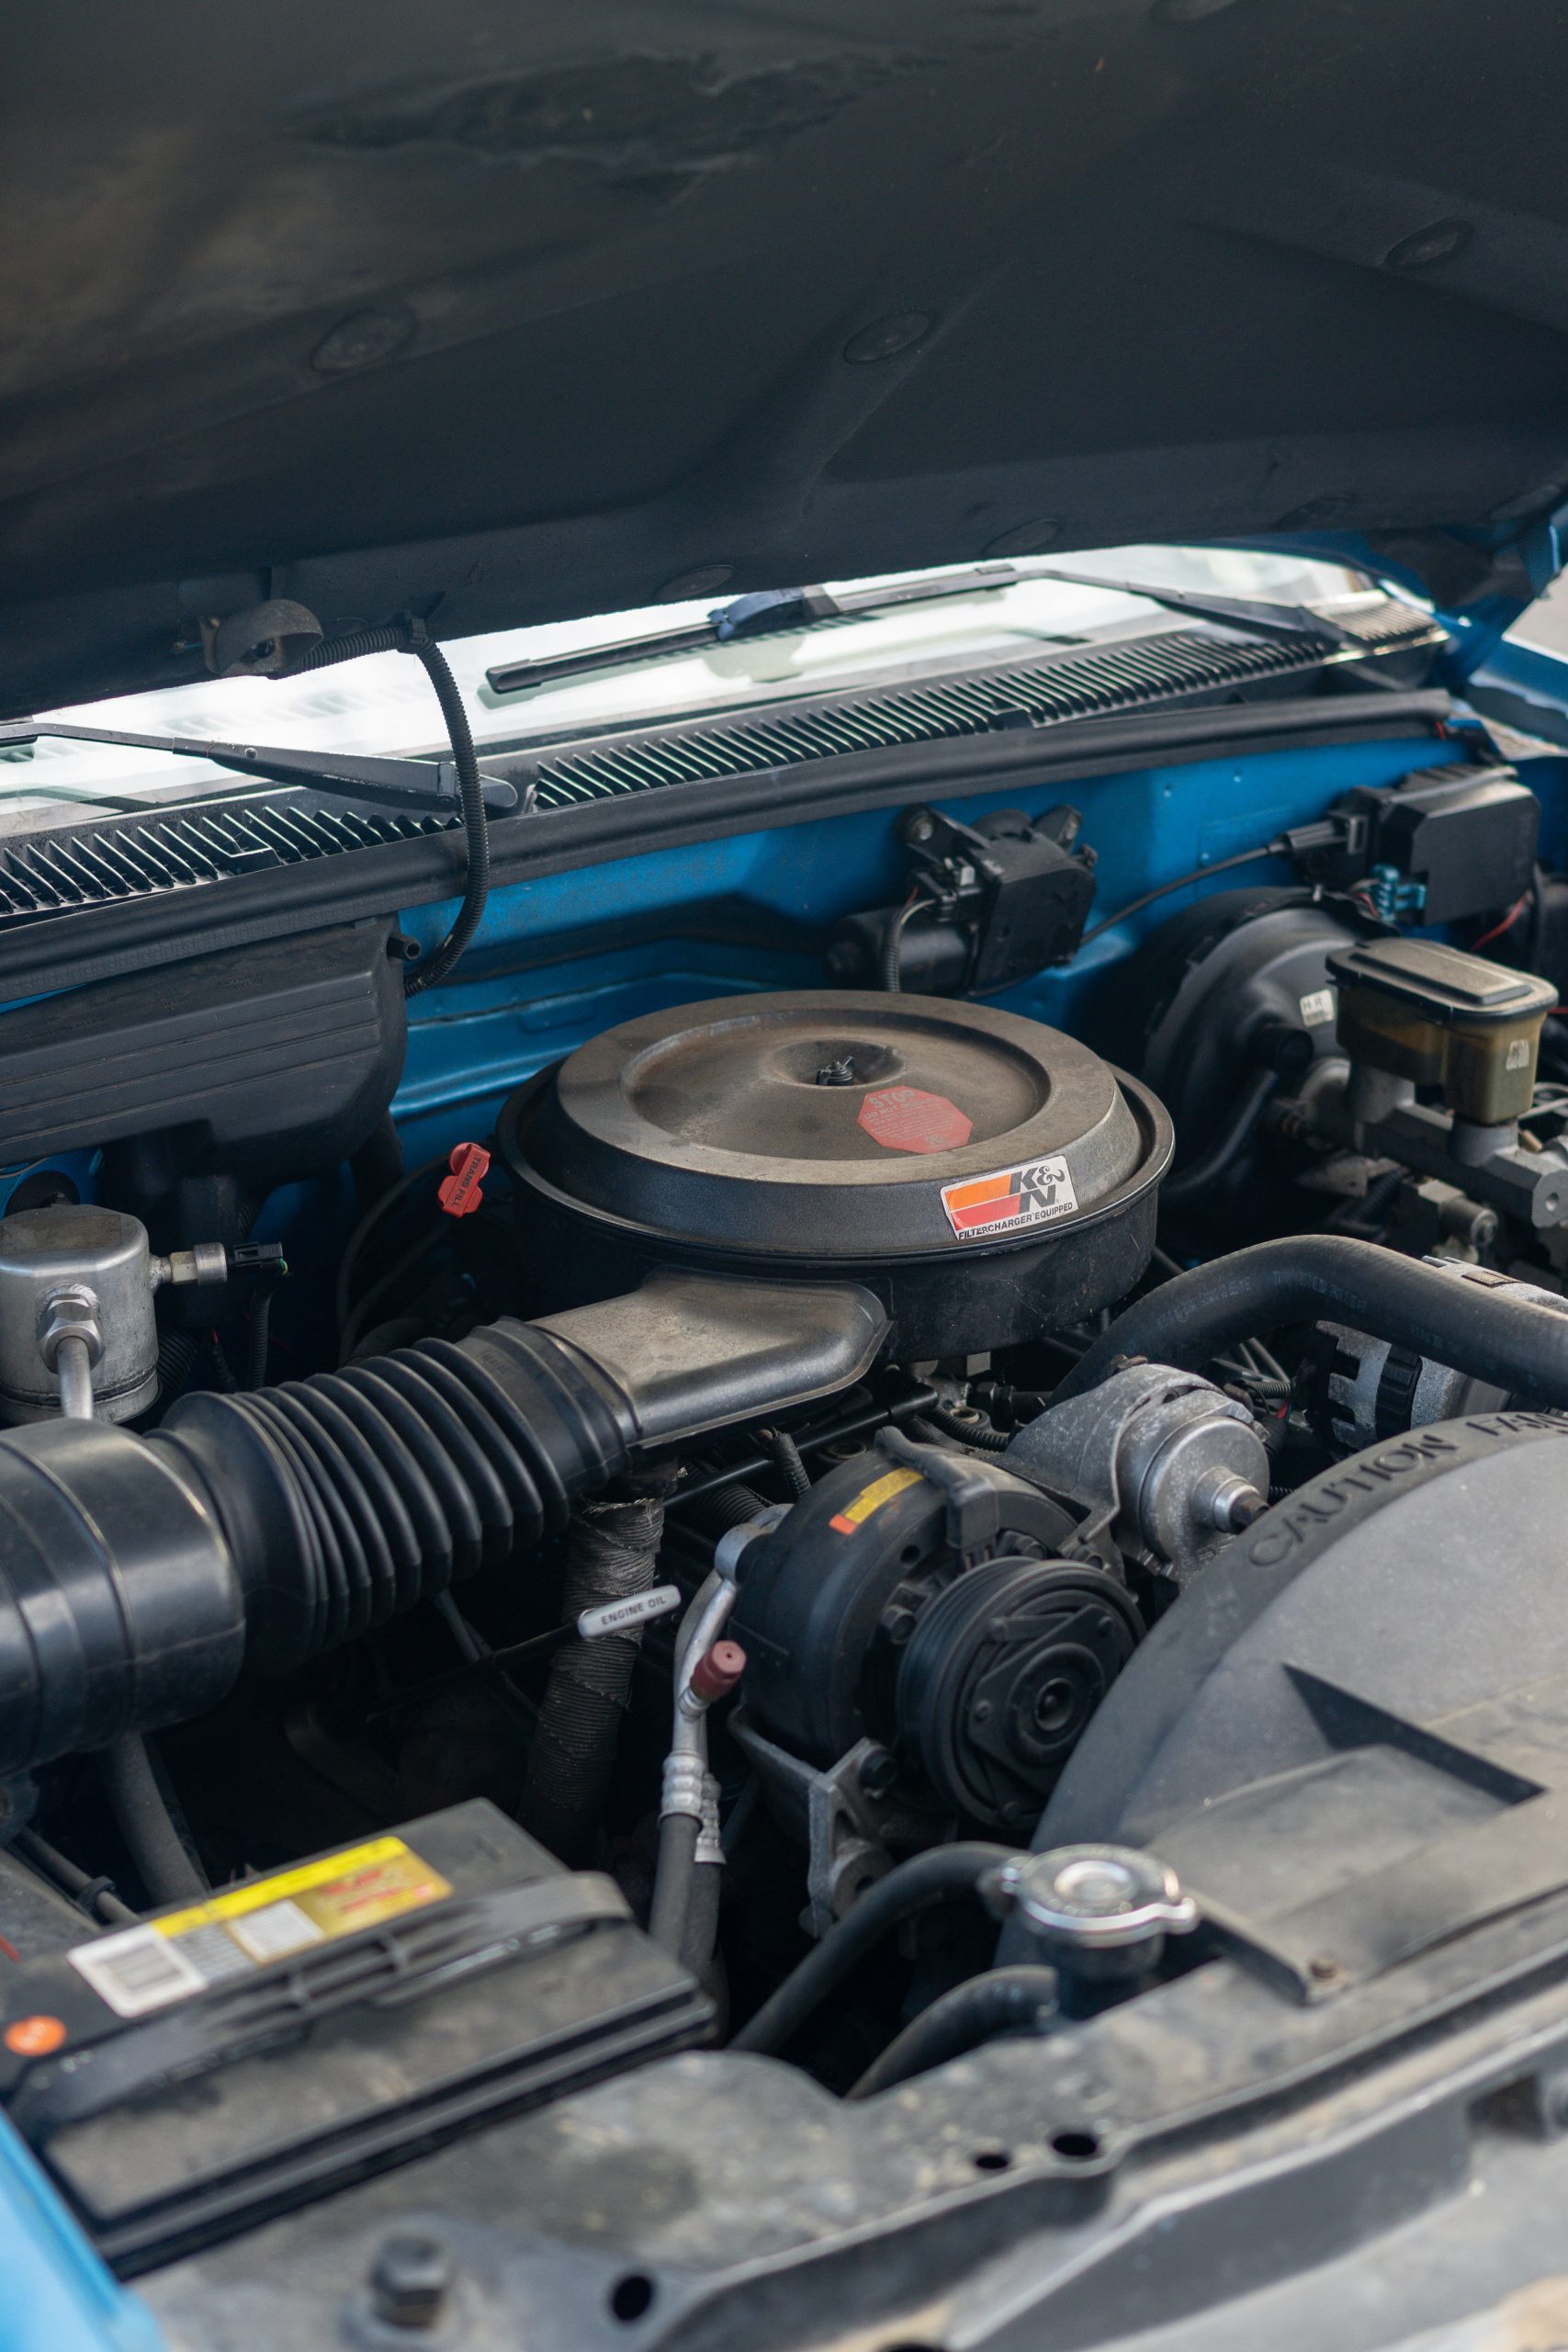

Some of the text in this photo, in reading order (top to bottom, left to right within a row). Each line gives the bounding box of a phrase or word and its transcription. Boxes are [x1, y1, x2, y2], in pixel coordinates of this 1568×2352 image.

[868, 1090, 916, 1110] STOP
[462, 1157, 482, 1189] TRANS
[958, 1202, 1073, 1240] FILTERCHARGER EQUIPPED
[1249, 1433, 1459, 1566] CAUTION
[601, 1596, 667, 1625] ENGINE OIL
